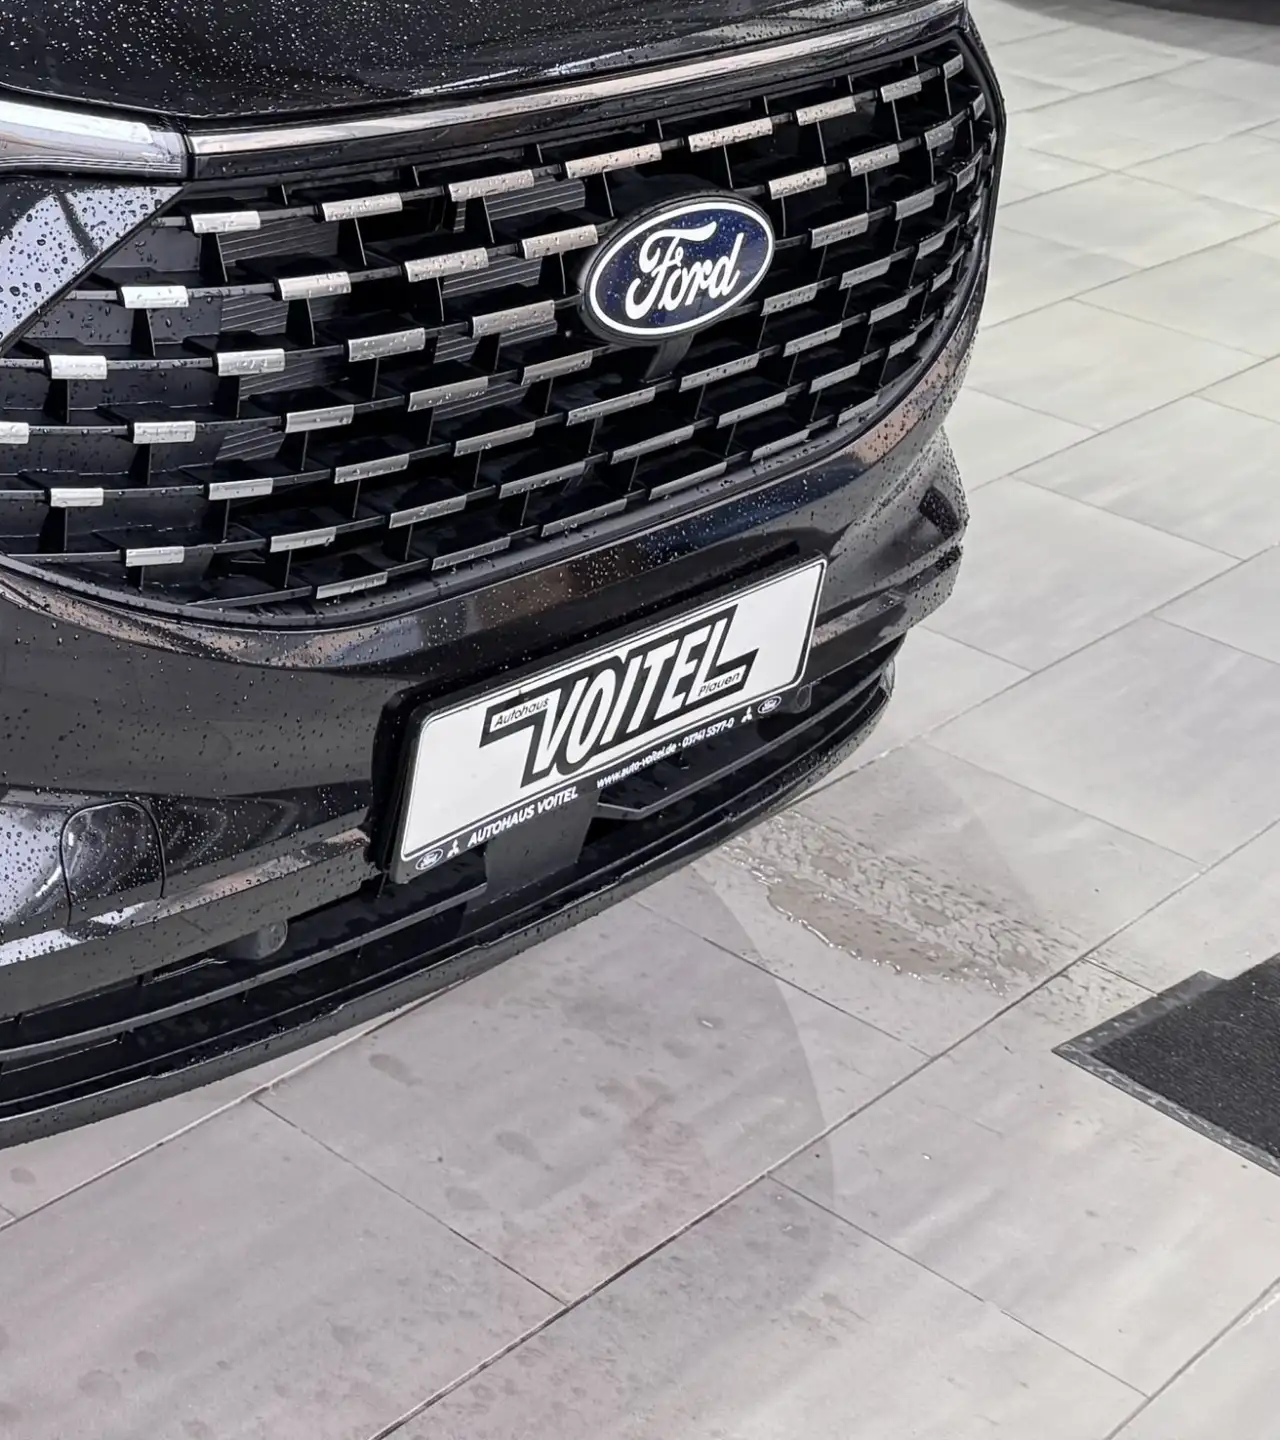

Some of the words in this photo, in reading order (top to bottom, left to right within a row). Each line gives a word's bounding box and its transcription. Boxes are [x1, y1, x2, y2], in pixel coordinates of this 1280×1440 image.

[622, 218, 746, 321] Ford
[493, 696, 551, 729] Autohaus
[521, 607, 740, 783] VOITEL
[697, 670, 741, 698] Plauen
[466, 804, 536, 847] AUTOHAUS
[537, 785, 579, 814] VOITEL
